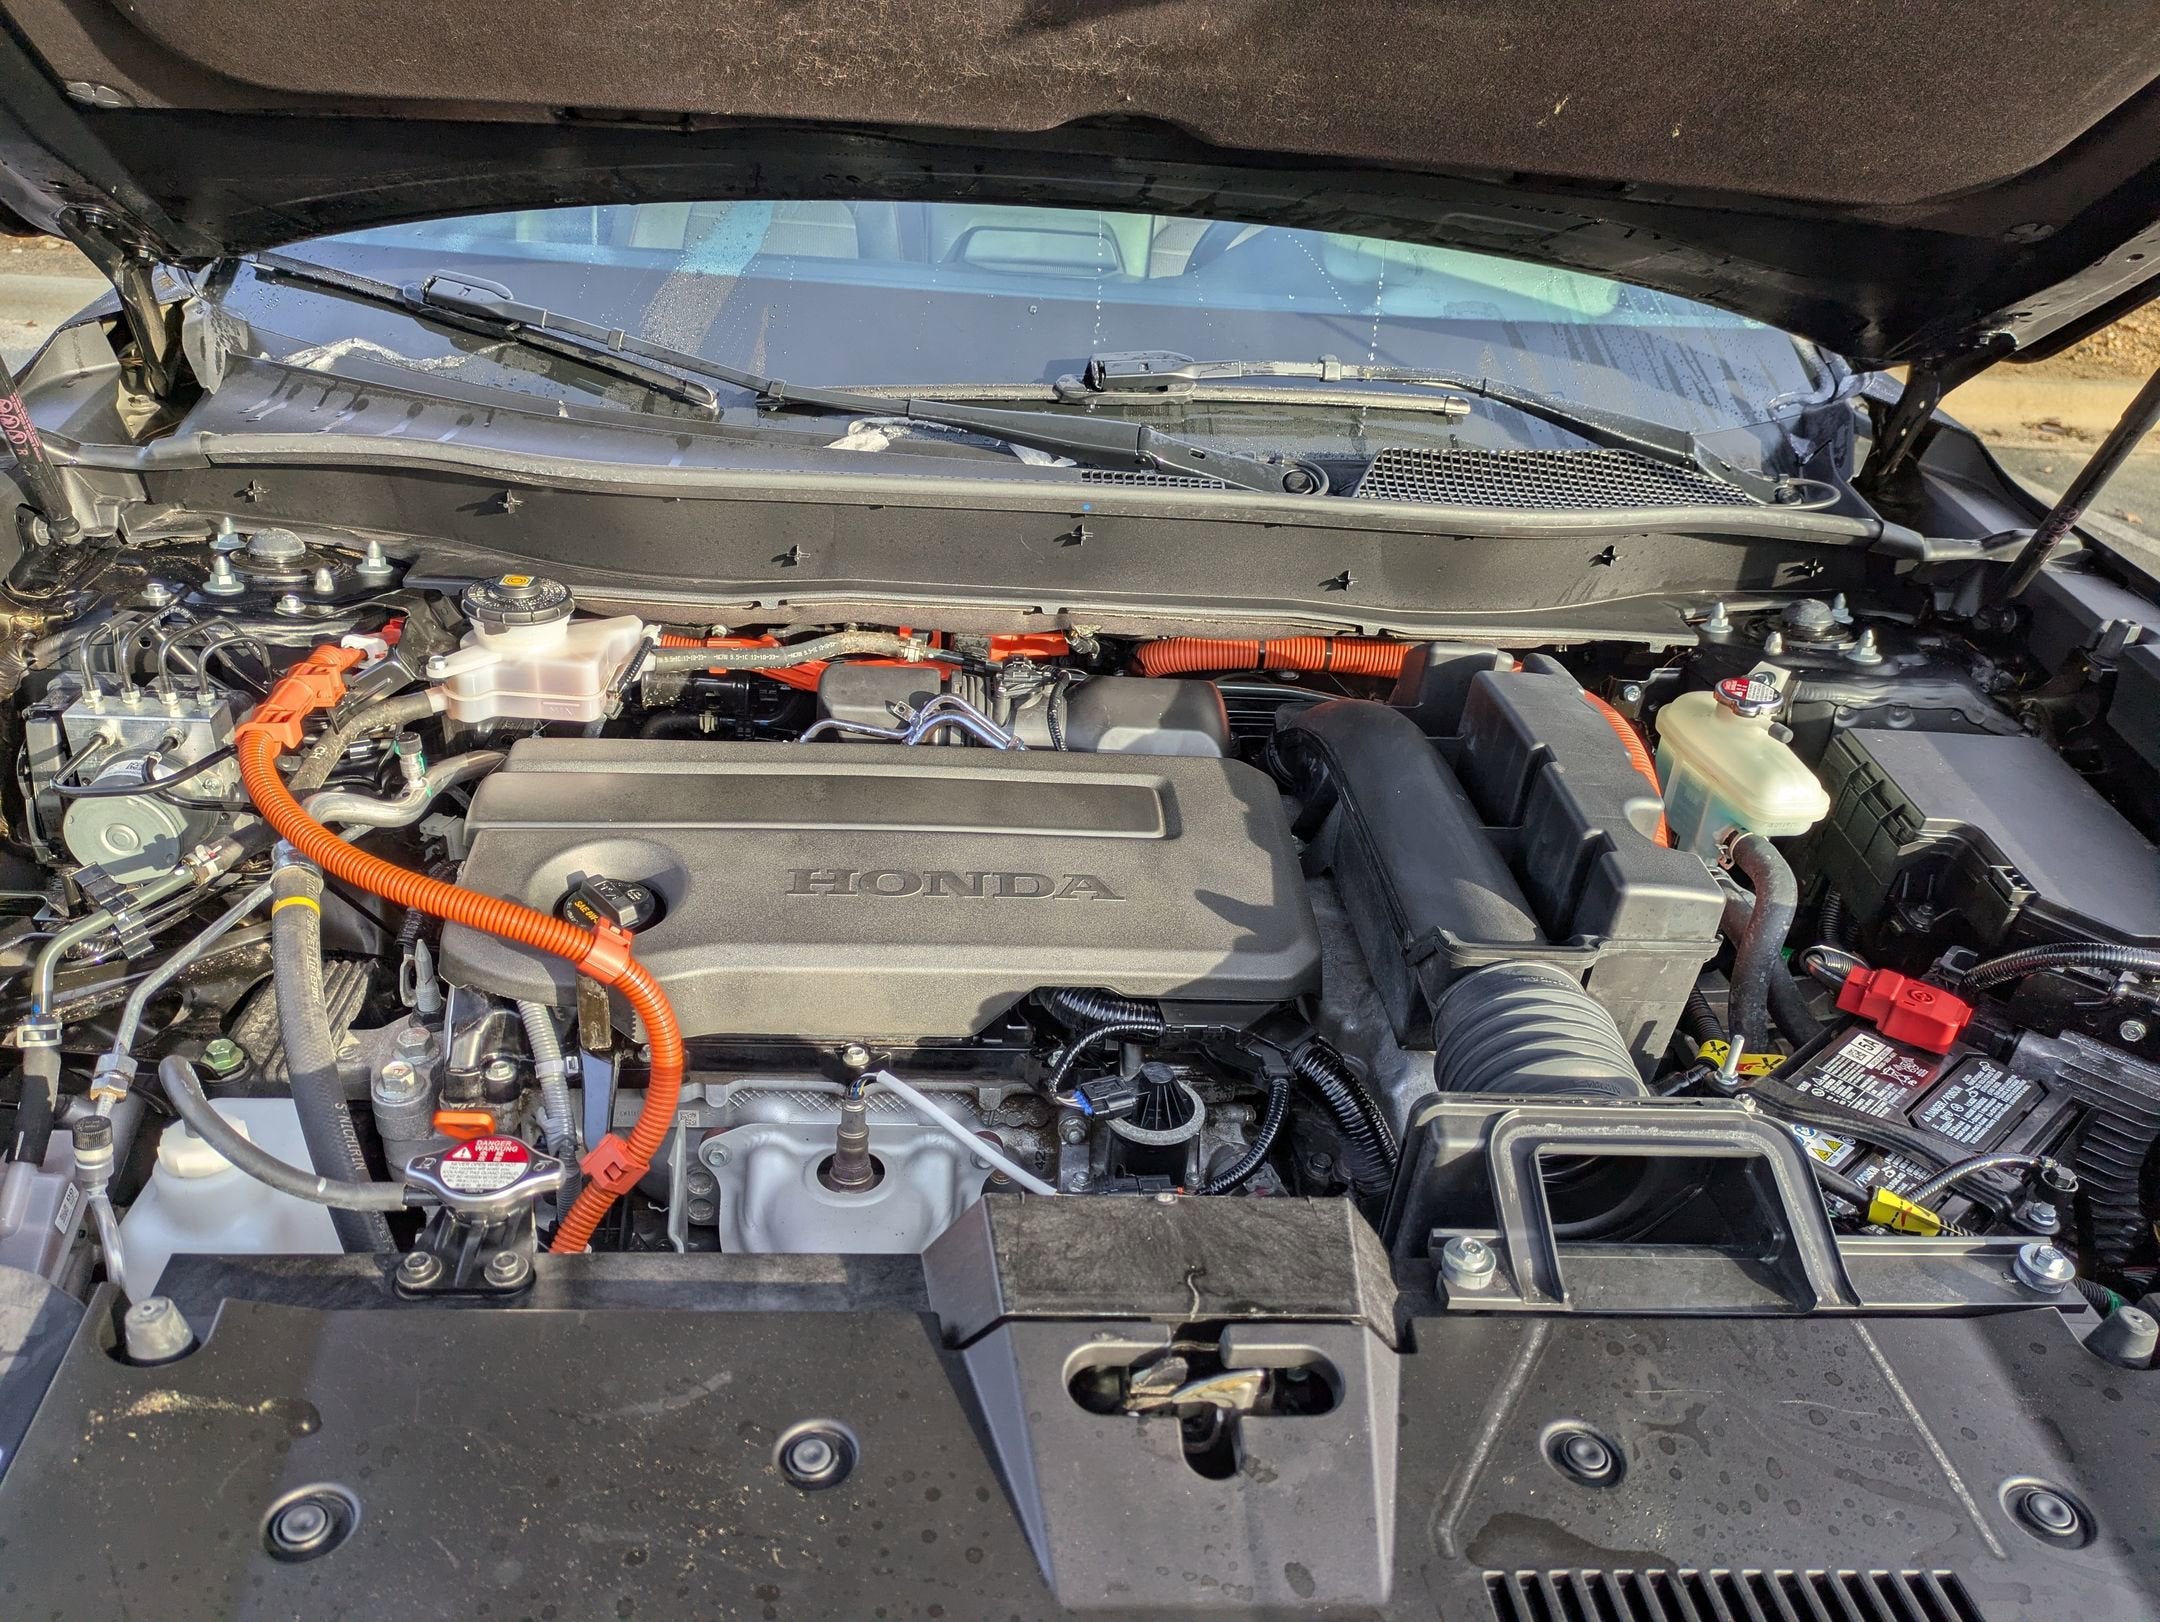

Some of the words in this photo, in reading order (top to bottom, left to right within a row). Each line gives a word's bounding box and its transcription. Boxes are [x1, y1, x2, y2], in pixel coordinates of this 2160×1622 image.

[785, 868, 1127, 902] HONDA
[574, 900, 590, 913] SAE
[1858, 1038, 1880, 1051] 5A
[474, 1145, 519, 1153] WARNUNG
[476, 1139, 512, 1147] DANGER
